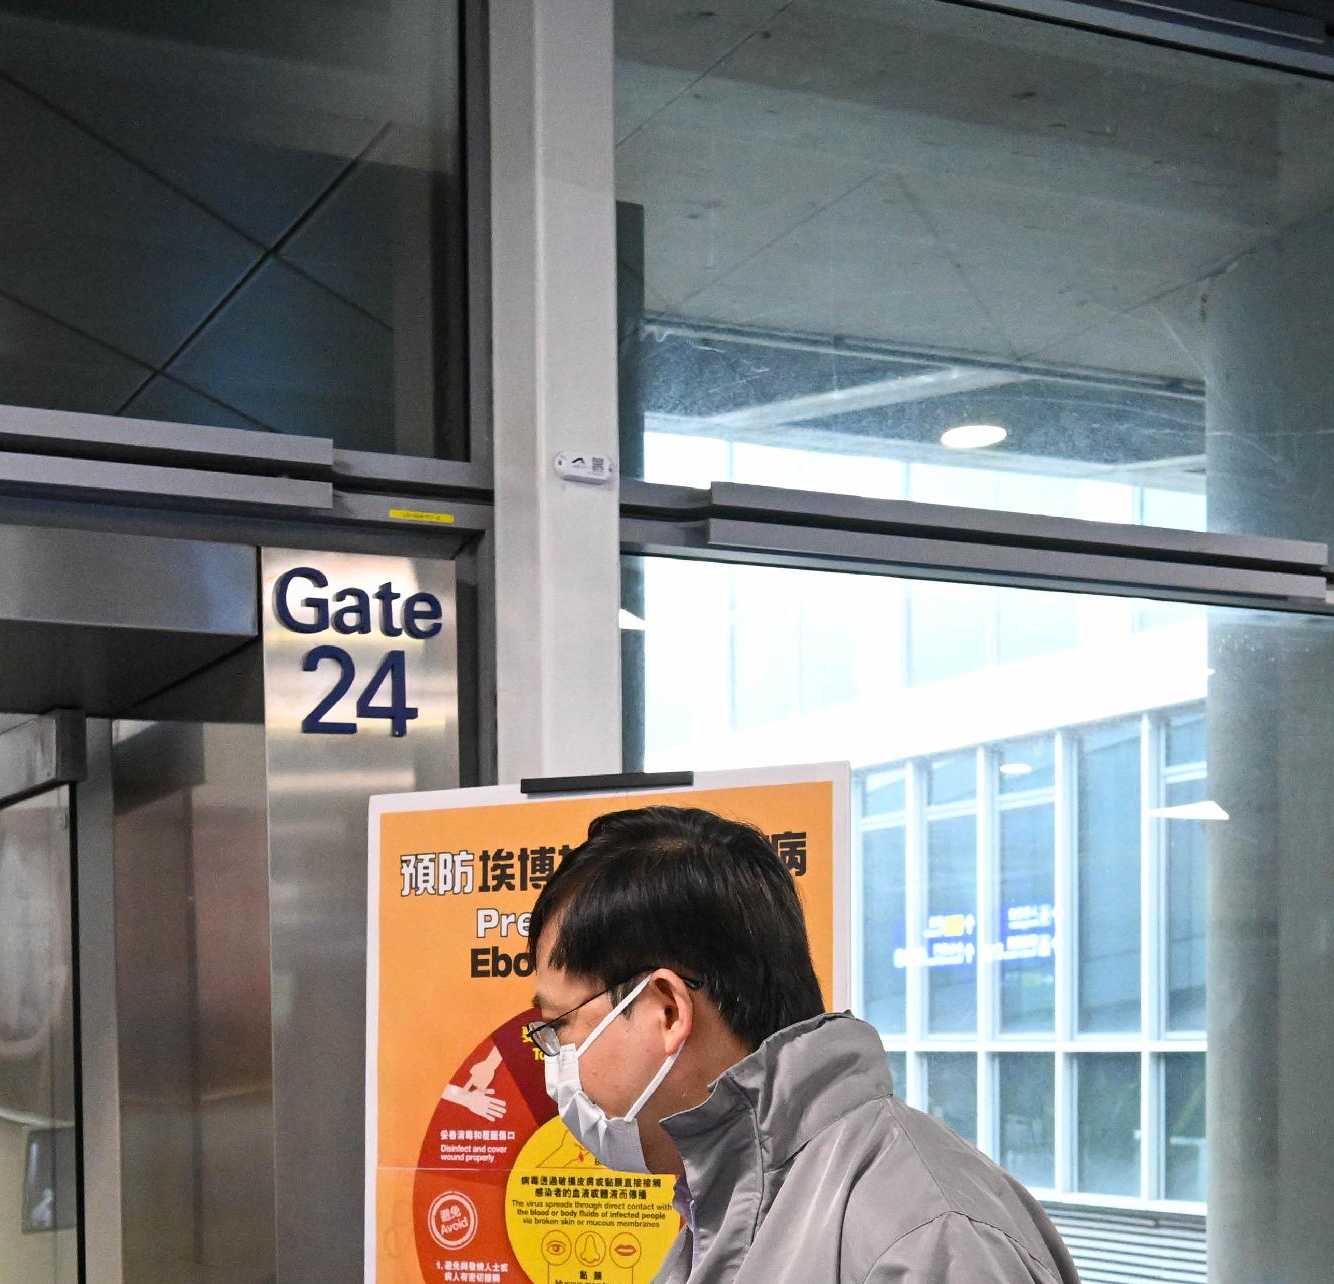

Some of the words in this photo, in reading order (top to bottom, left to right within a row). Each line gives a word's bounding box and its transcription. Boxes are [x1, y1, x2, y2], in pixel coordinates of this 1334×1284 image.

[273, 567, 443, 640] Gate
[301, 645, 419, 738] 24
[476, 907, 534, 938] Pre
[470, 946, 535, 978] Ebo
[440, 1144, 471, 1153] Disinfect
[473, 1145, 486, 1153] and
[487, 1146, 507, 1154] cover
[441, 1153, 465, 1161] wound
[465, 1154, 495, 1163] properly
[512, 1199, 524, 1207] The
[545, 1201, 572, 1210] spreads
[574, 1201, 602, 1211] through
[604, 1202, 625, 1210] direct
[627, 1203, 654, 1211] contact
[656, 1203, 673, 1211] with
[560, 1209, 577, 1217] body
[579, 1210, 599, 1218] fluids
[610, 1211, 639, 1219] infected
[641, 1212, 665, 1220] people
[441, 1216, 469, 1236] Avoid
[617, 1220, 659, 1228] membranes
[436, 1261, 444, 1270] 1.
